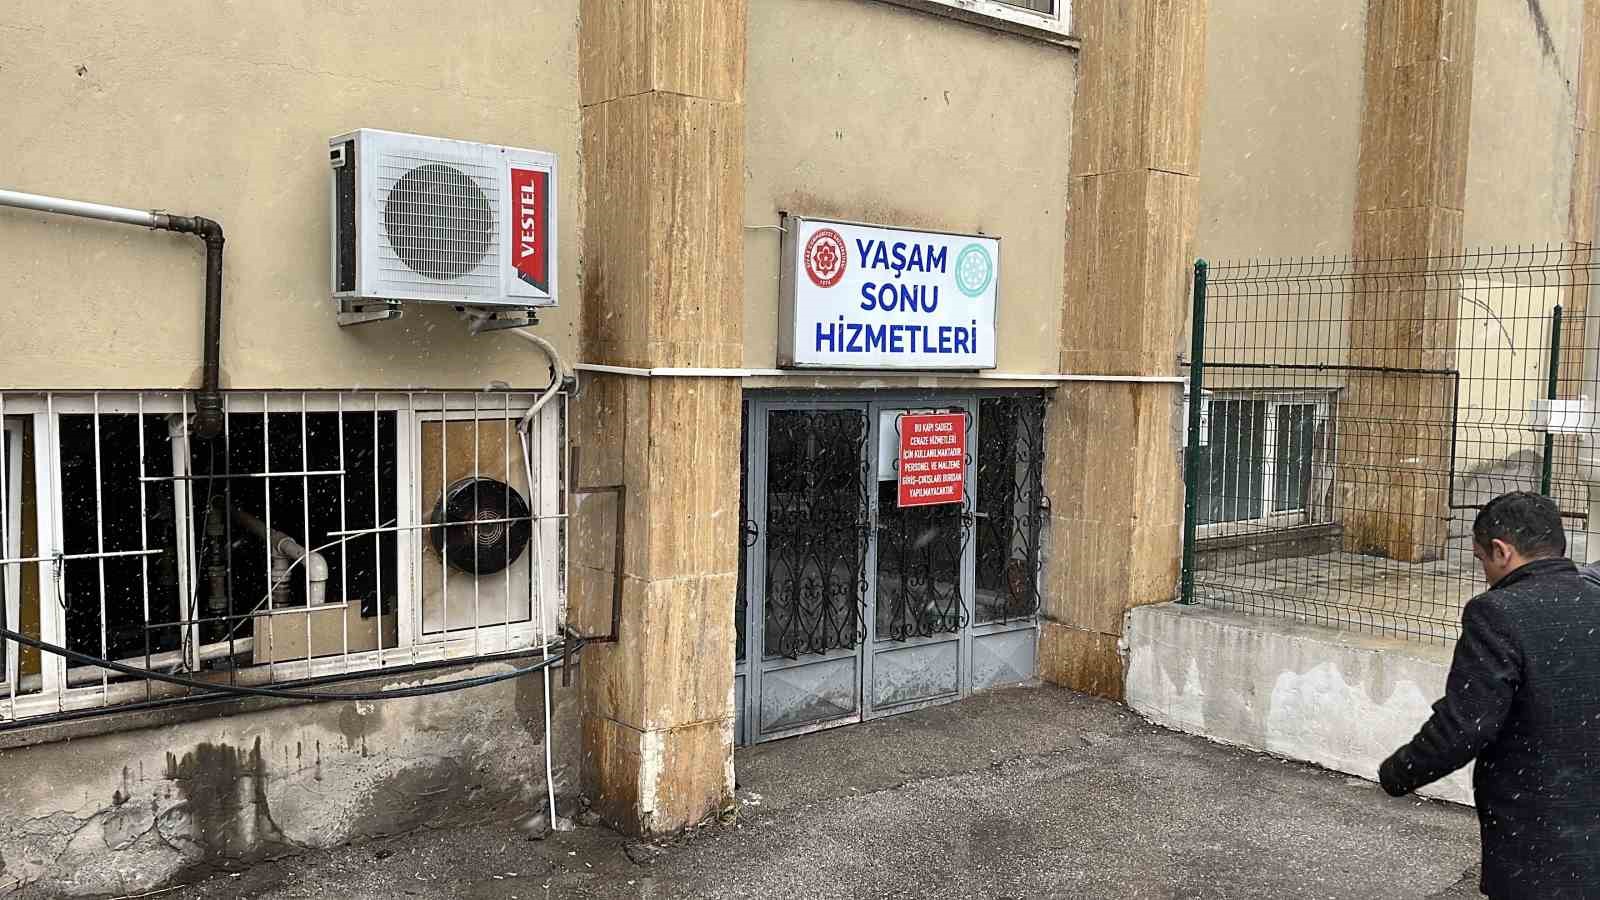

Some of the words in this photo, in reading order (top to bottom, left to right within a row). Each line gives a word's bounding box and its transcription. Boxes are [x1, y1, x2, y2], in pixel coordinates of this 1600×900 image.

[521, 179, 535, 258] VESTEL
[855, 238, 948, 278] YAŞAM
[860, 282, 938, 313] SONU
[815, 315, 977, 354] HİZMETLERİ
[923, 423, 933, 432] KAPI
[934, 422, 952, 431] SADECE
[904, 461, 929, 471] PERSONEL
[931, 461, 937, 470] VE
